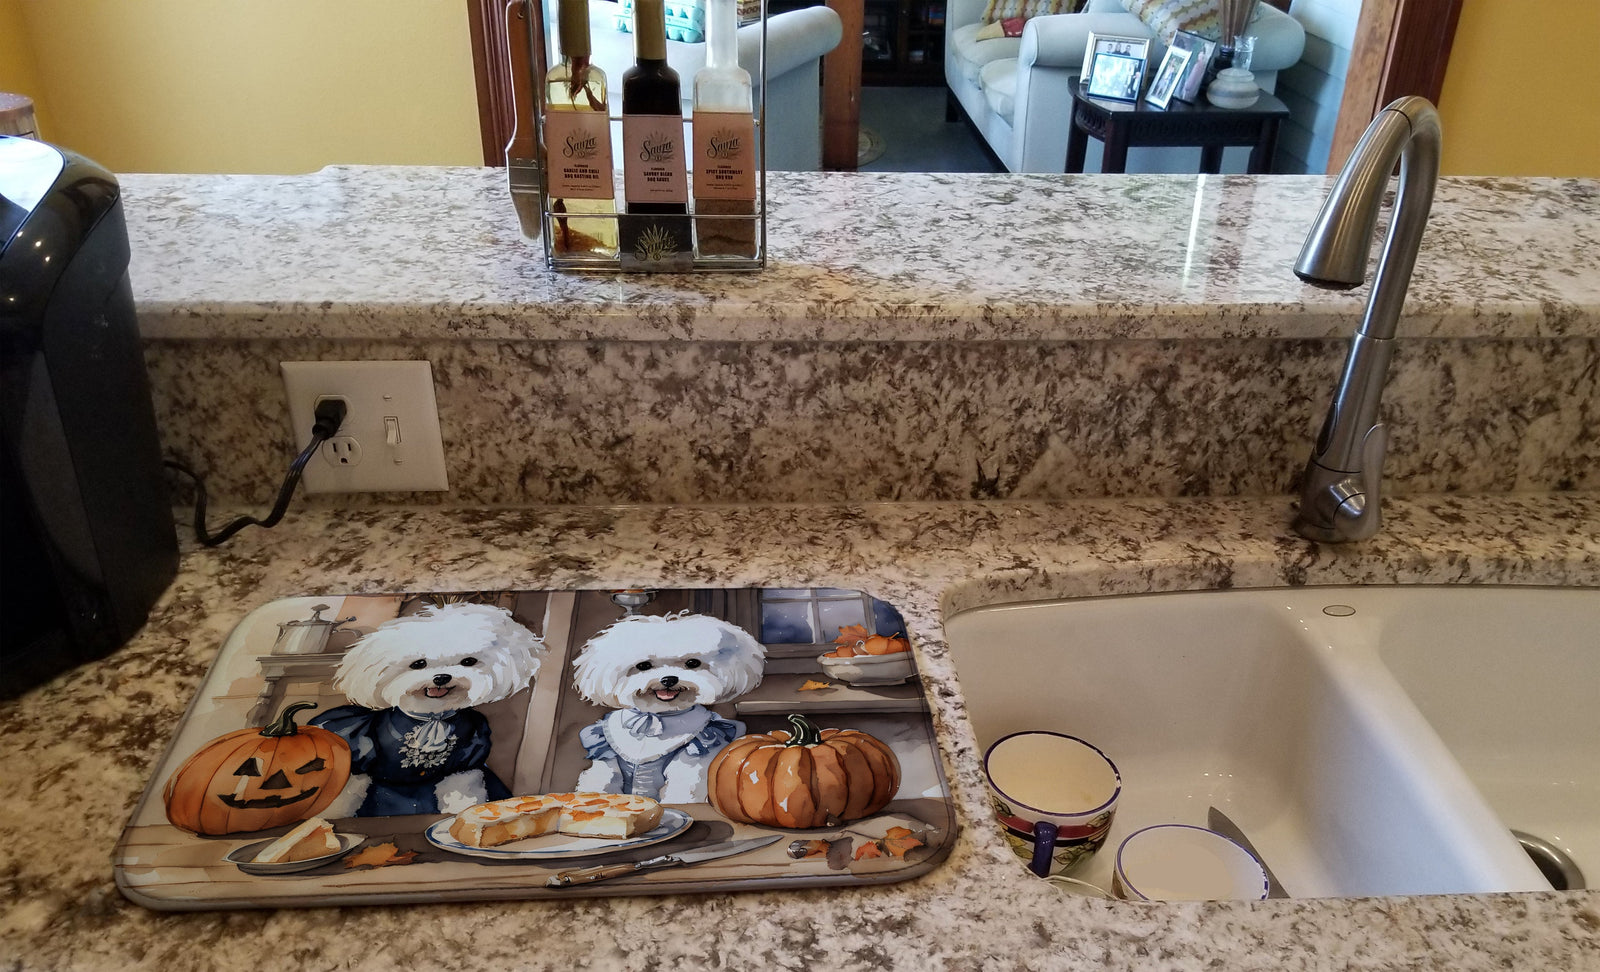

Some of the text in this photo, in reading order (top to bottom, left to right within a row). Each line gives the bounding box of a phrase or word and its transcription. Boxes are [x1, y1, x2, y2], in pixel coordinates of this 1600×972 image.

[563, 136, 598, 158] Sauza
[640, 140, 674, 161] Sauza
[707, 136, 740, 159] Sauza
